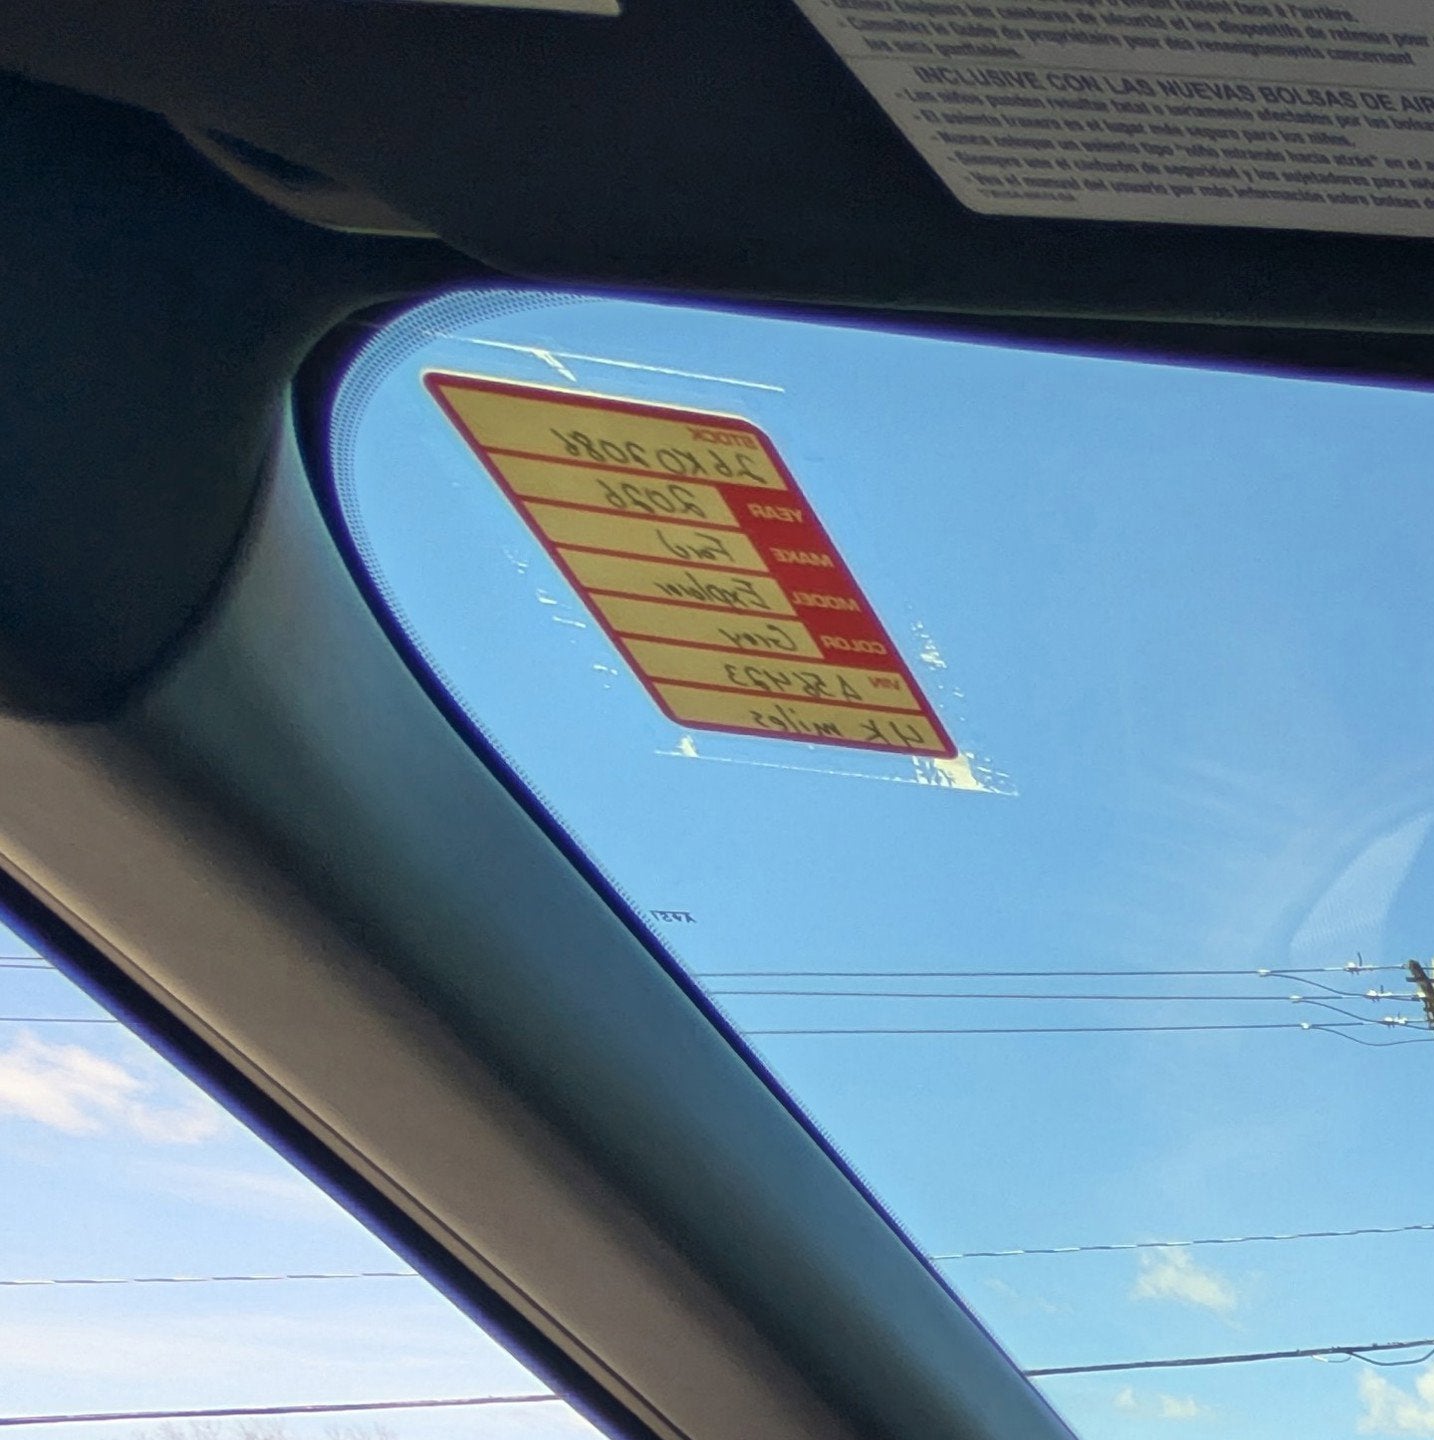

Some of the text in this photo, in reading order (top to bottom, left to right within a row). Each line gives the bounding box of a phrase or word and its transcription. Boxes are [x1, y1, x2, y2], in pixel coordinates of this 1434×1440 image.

[913, 66, 1041, 90] INCLUSIVE
[1048, 73, 1100, 92] CON
[1104, 76, 1155, 96] LAS
[1157, 79, 1255, 103] NUEVAS
[1260, 85, 1357, 109] BOLSAS
[1360, 92, 1397, 111] DE
